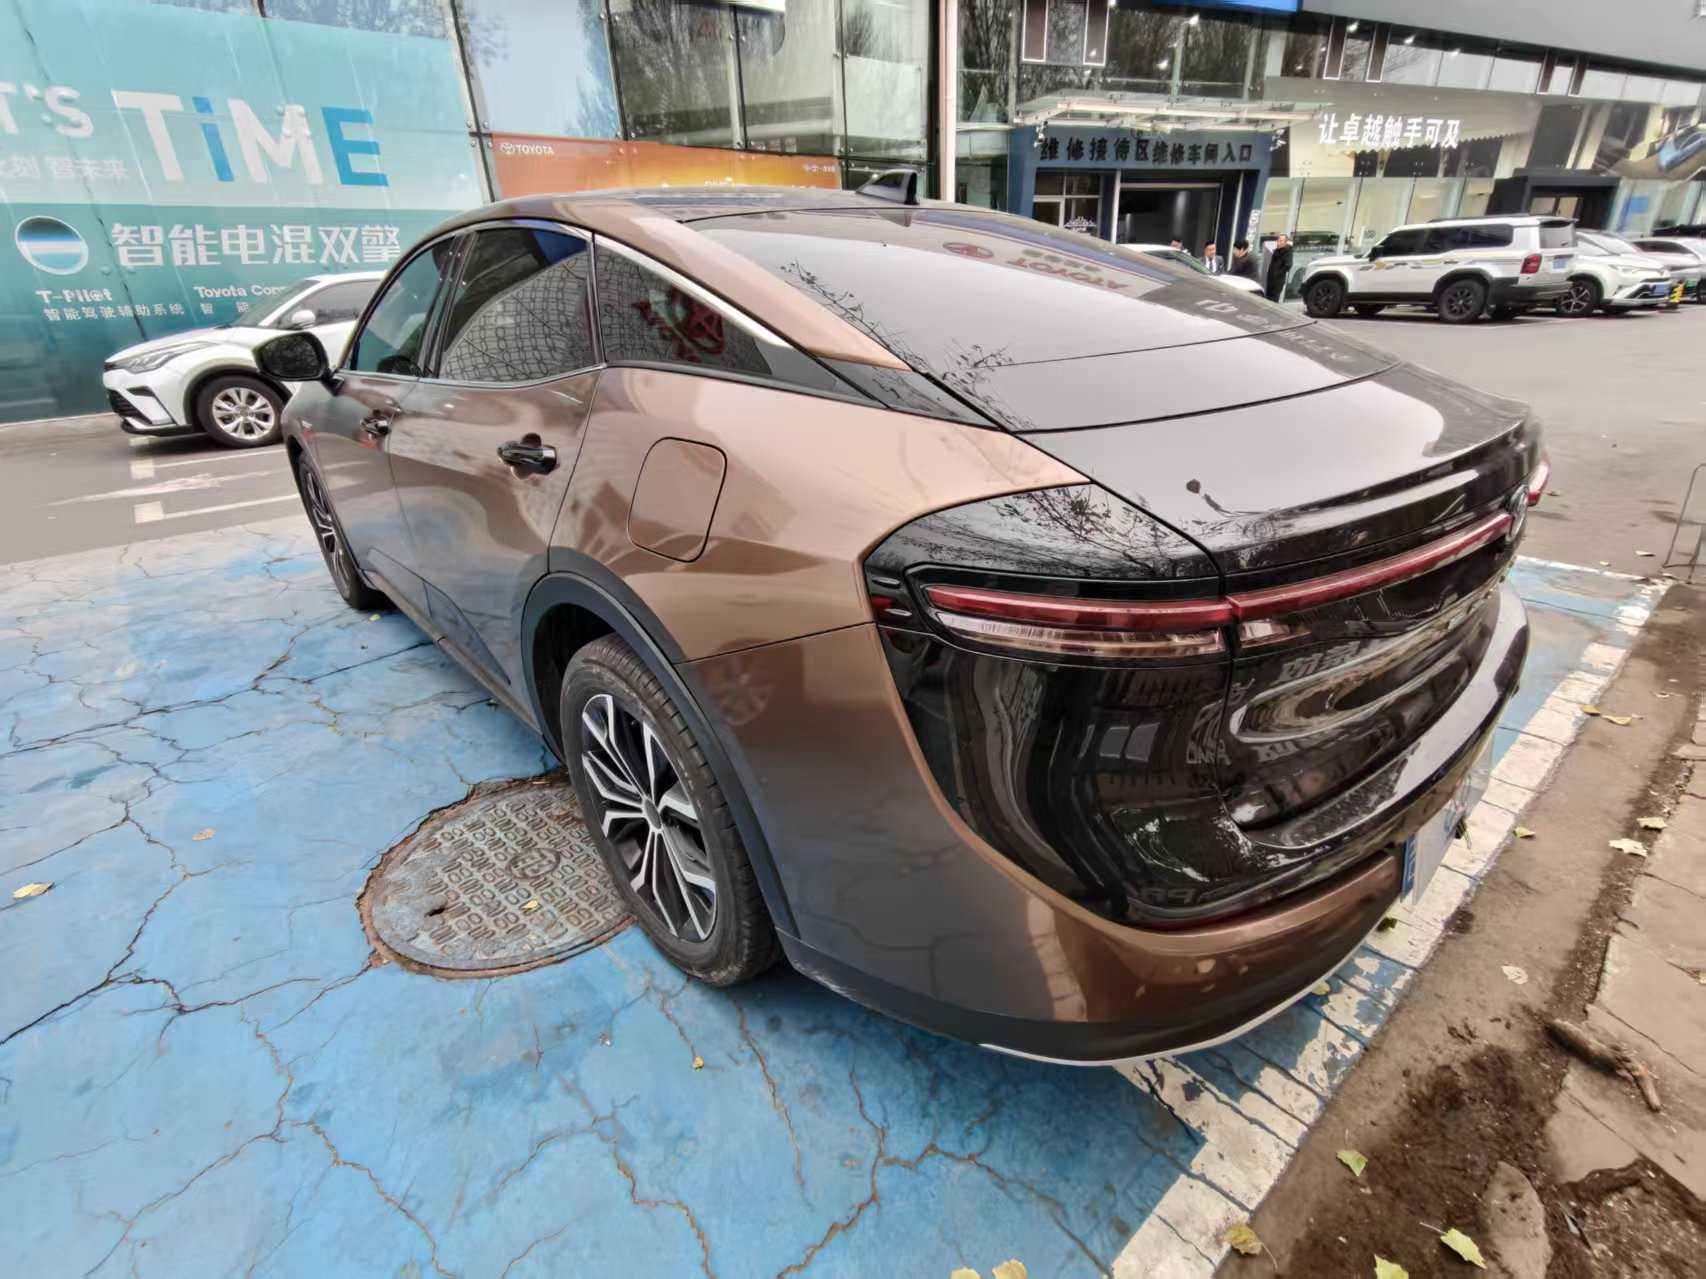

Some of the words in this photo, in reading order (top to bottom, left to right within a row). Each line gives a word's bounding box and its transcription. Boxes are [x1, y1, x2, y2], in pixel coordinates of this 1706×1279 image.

[1319, 113, 1460, 149] 让卓越触手可及
[514, 144, 555, 155] TOYOTA
[1039, 136, 1150, 162] 维修接待区
[1151, 139, 1253, 165] 维修车间入口
[111, 223, 401, 267] 智能电混双擎
[192, 285, 248, 298] Toyota
[43, 303, 184, 321] 智能驾驶辅助系统
